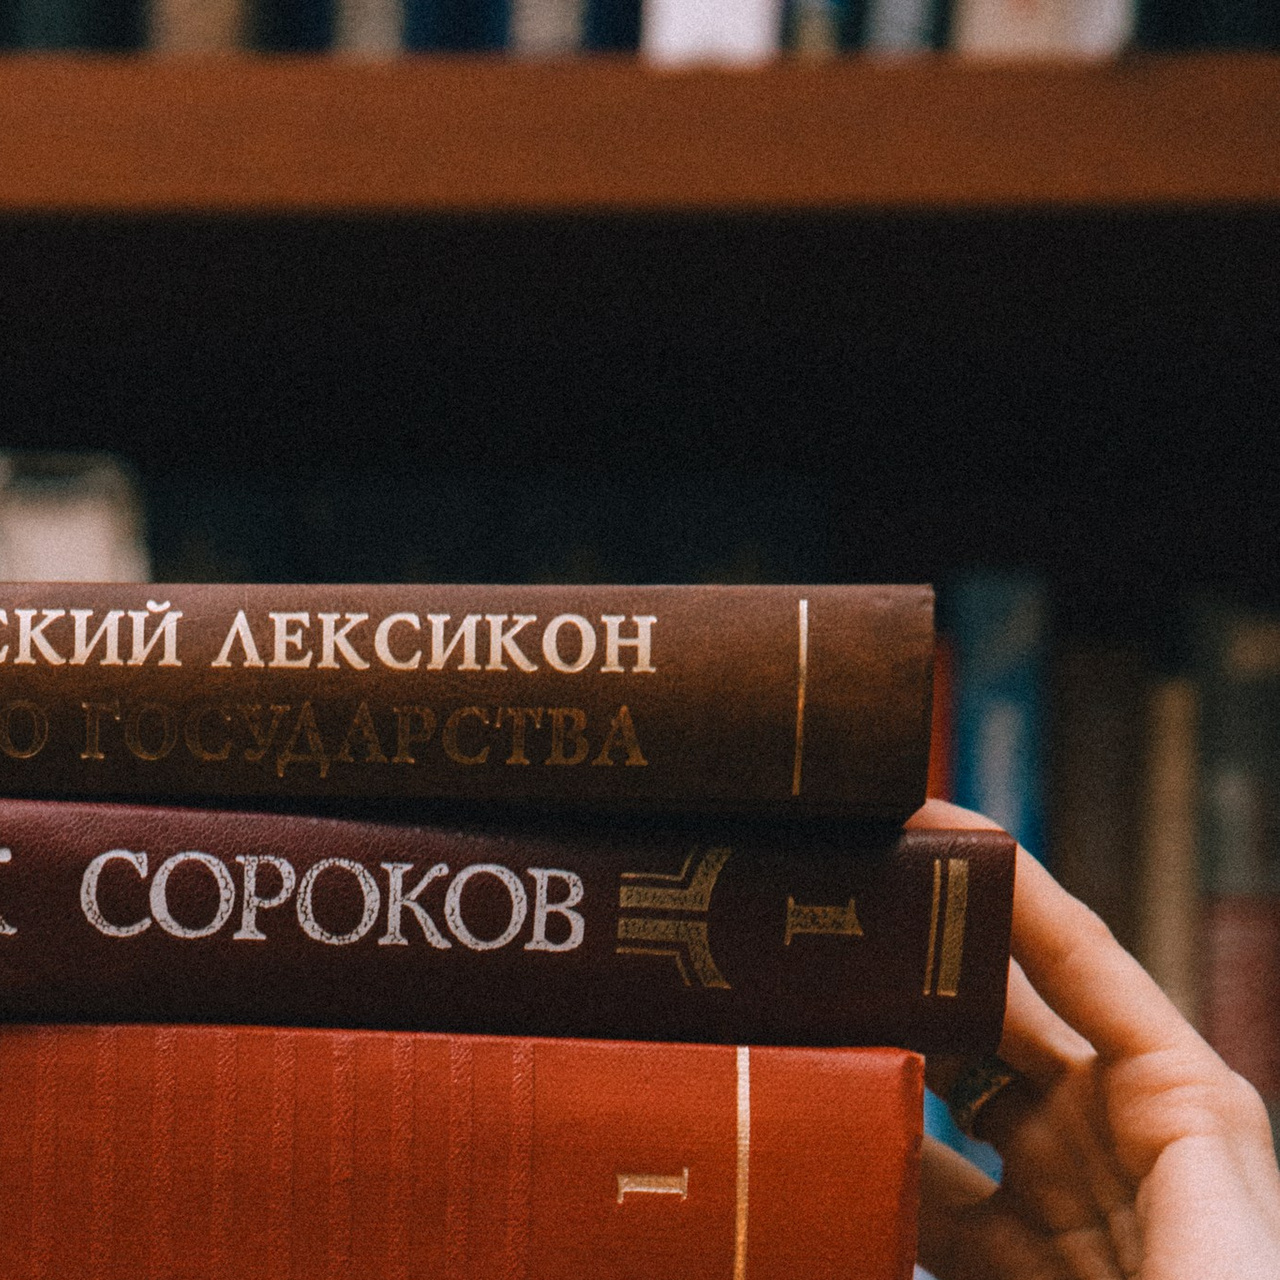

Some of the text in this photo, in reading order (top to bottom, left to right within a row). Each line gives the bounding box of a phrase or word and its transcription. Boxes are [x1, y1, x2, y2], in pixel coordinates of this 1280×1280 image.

[212, 611, 658, 674] ЛЕКСИКОН
[80, 701, 650, 778] ГОСУДАРСТВА
[80, 849, 585, 953] СОРОКОВ
[784, 895, 864, 946] 1
[616, 1166, 689, 1204] 1
